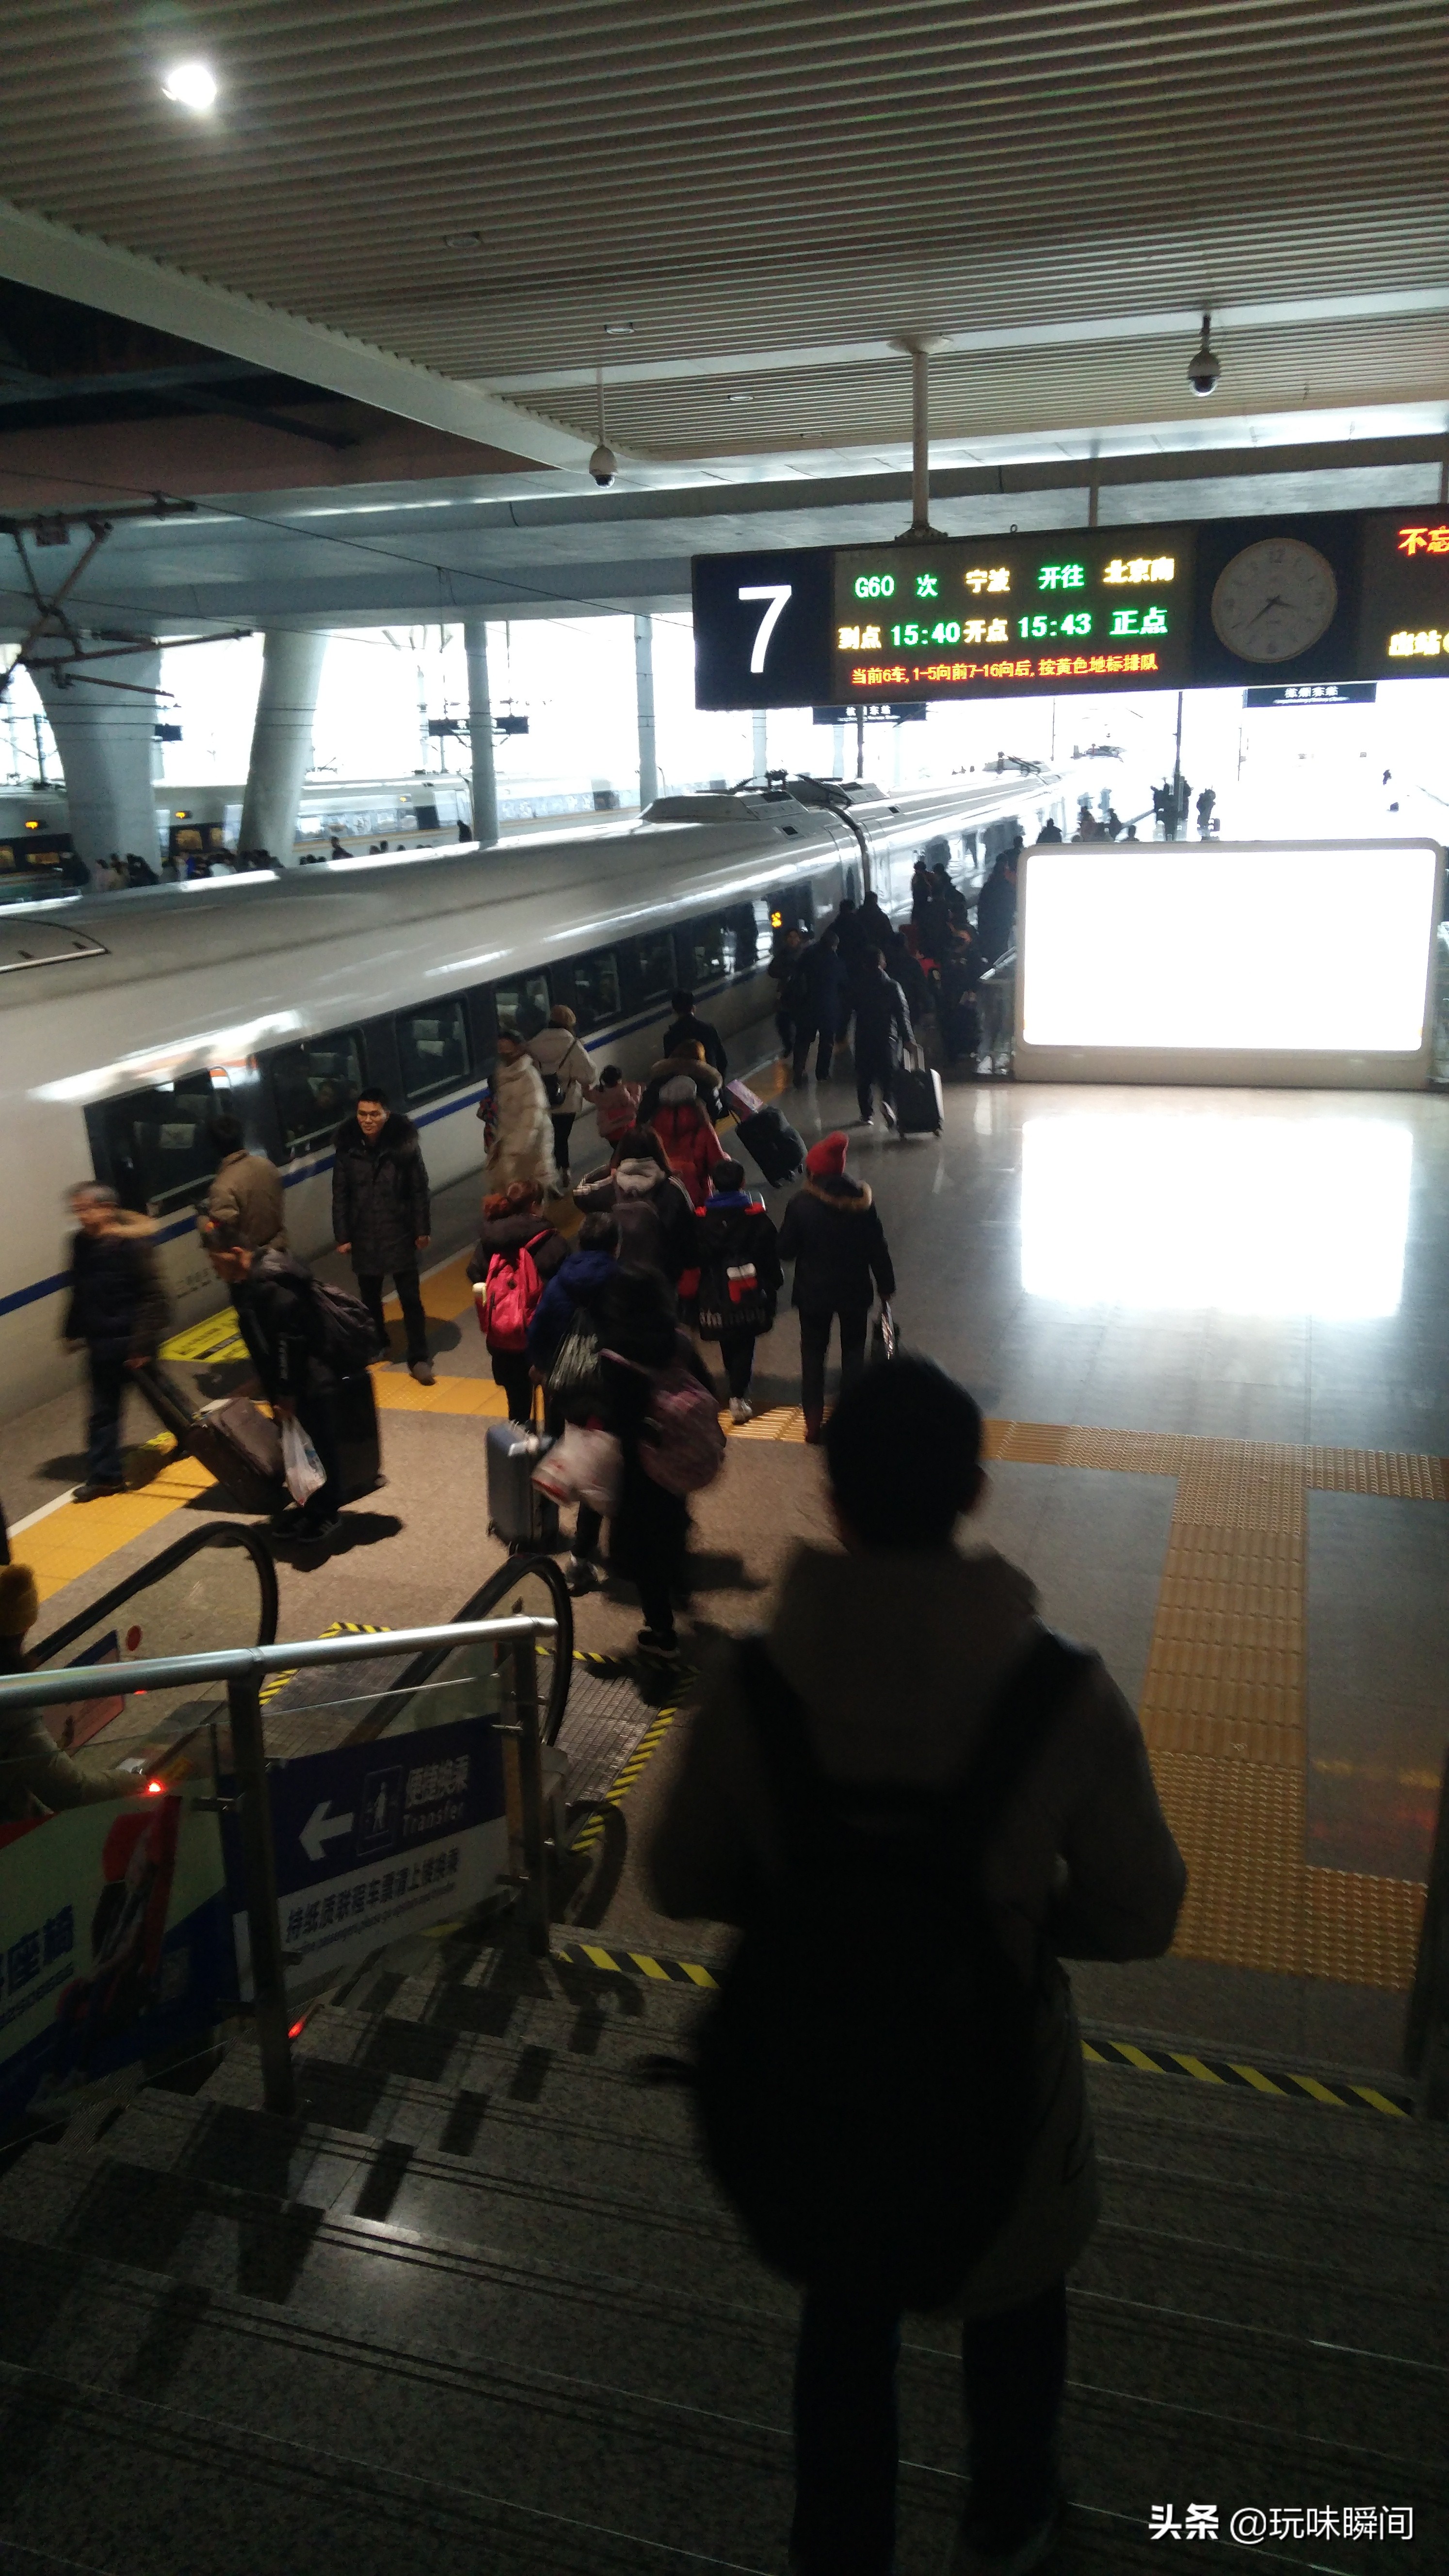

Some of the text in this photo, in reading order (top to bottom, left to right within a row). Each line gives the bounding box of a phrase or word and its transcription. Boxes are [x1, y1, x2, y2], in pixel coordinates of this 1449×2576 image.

[855, 557, 1175, 598] G60 次 宁波 开往 北京南
[739, 585, 792, 674] 7
[838, 606, 1169, 650] 到点 15:40 开点 15:43 正点
[1388, 630, 1449, 657] 出站
[402, 1800, 465, 1837] Transfer
